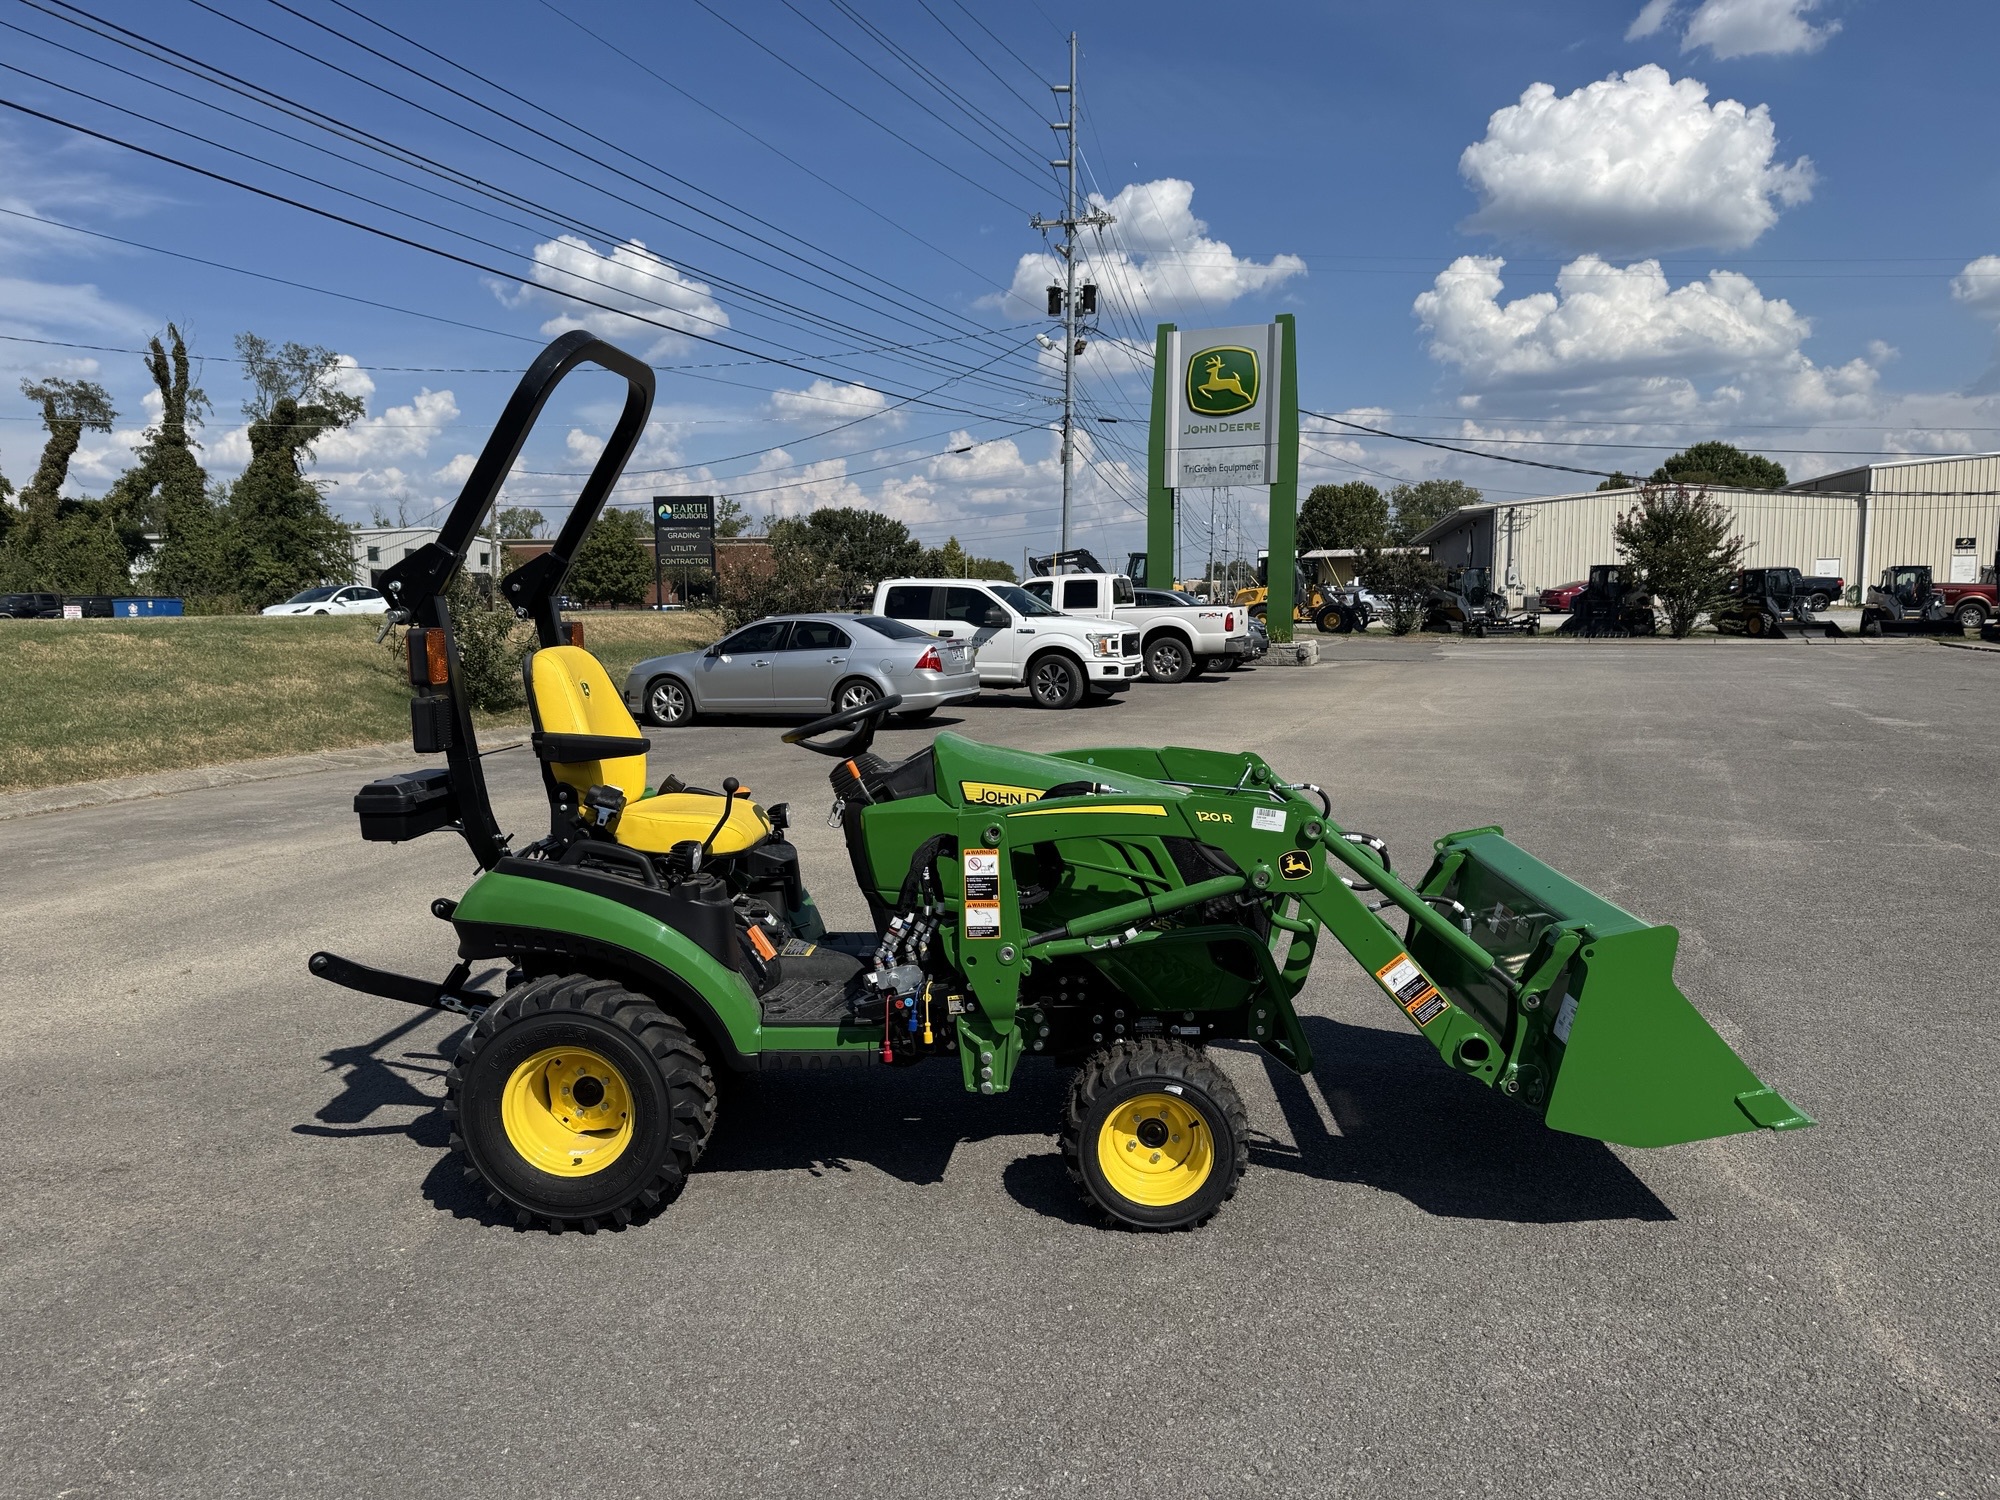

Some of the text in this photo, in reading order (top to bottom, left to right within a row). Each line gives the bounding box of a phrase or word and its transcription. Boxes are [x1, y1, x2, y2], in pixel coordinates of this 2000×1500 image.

[1184, 422, 1260, 435] JOHN DEERE
[1184, 463, 1259, 473] TriGreen Equipment
[672, 503, 707, 513] EARTH
[976, 788, 1021, 804] JOHN
[1195, 811, 1234, 823] 120 R
[1385, 957, 1404, 971] WARNING
[1416, 990, 1435, 1006] WARNING
